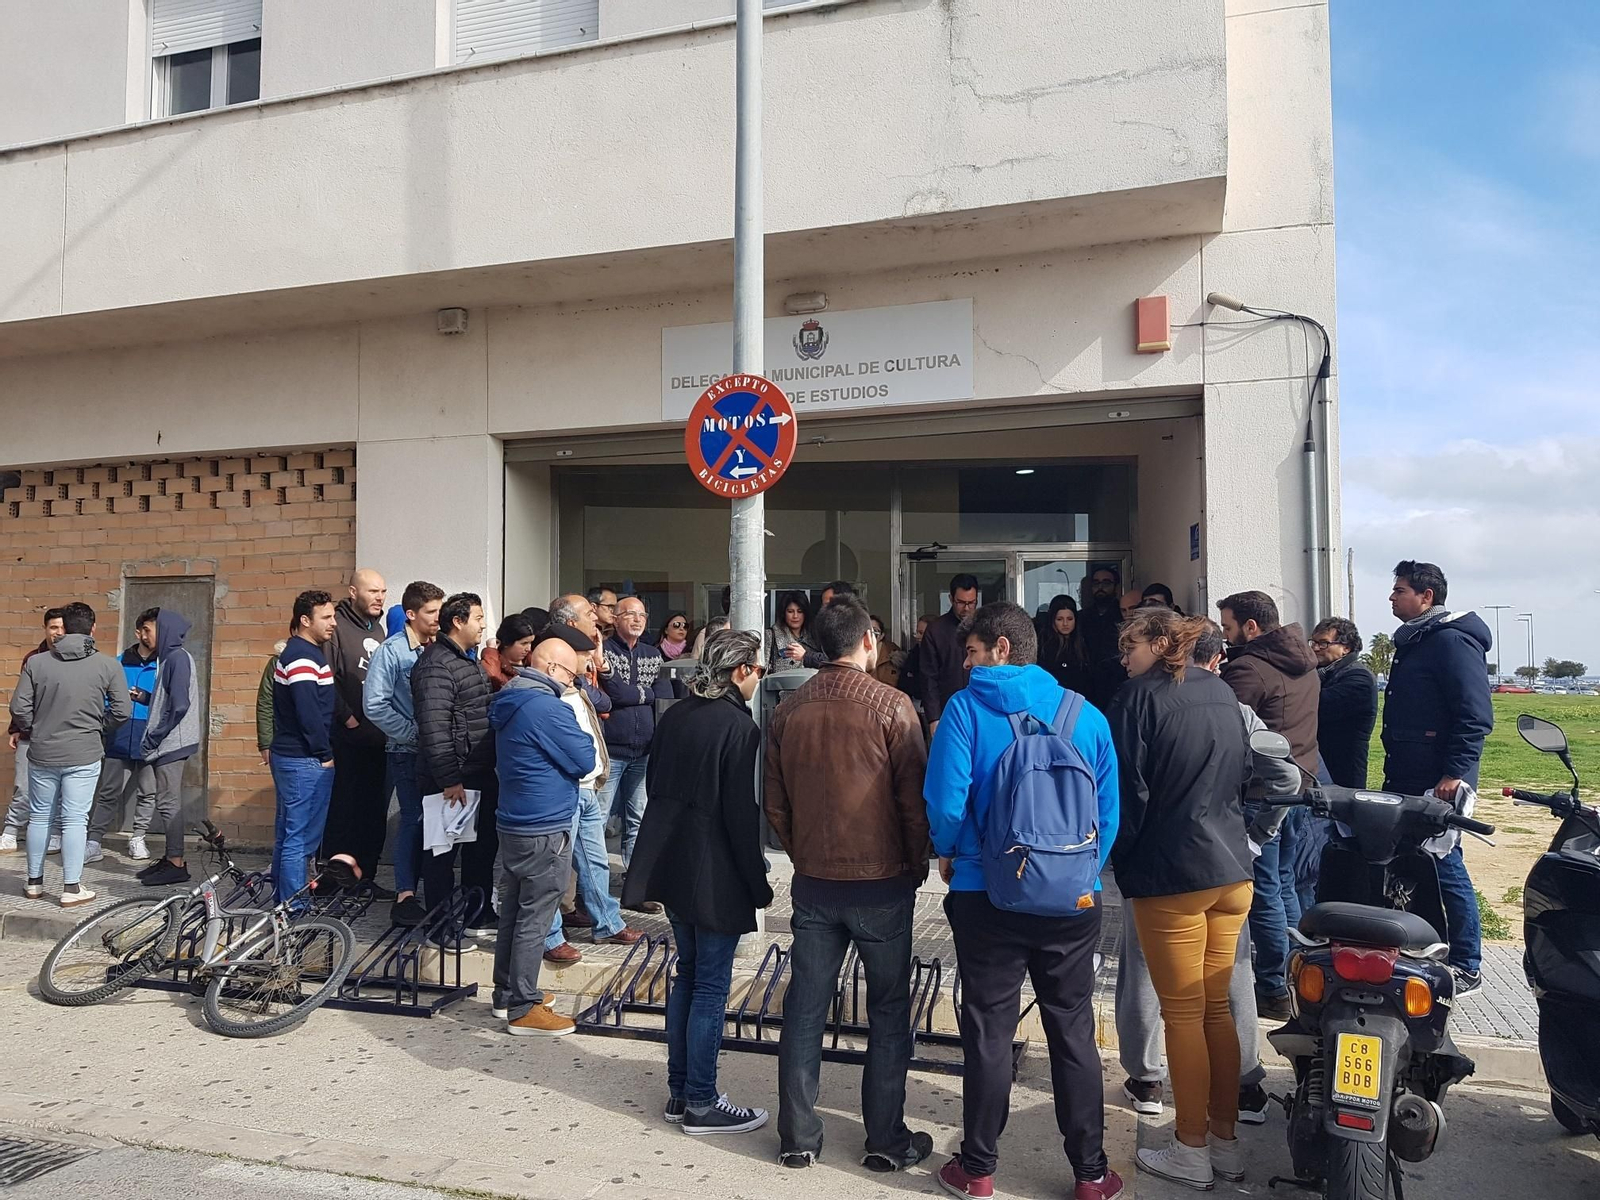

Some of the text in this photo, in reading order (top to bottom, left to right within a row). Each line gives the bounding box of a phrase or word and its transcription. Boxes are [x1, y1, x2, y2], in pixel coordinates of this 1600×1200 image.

[771, 364, 854, 382] MUNICIPAL
[858, 361, 880, 375] DE
[884, 353, 961, 373] CULTURA
[707, 376, 768, 401] EXCEPTO
[785, 384, 889, 404] DE ESTUDIOS
[703, 413, 766, 433] MOTOS
[735, 449, 746, 463] Y
[699, 459, 783, 494] BICICLETAS
[1344, 1056, 1372, 1071] 566
[1343, 1071, 1371, 1088] BDB
